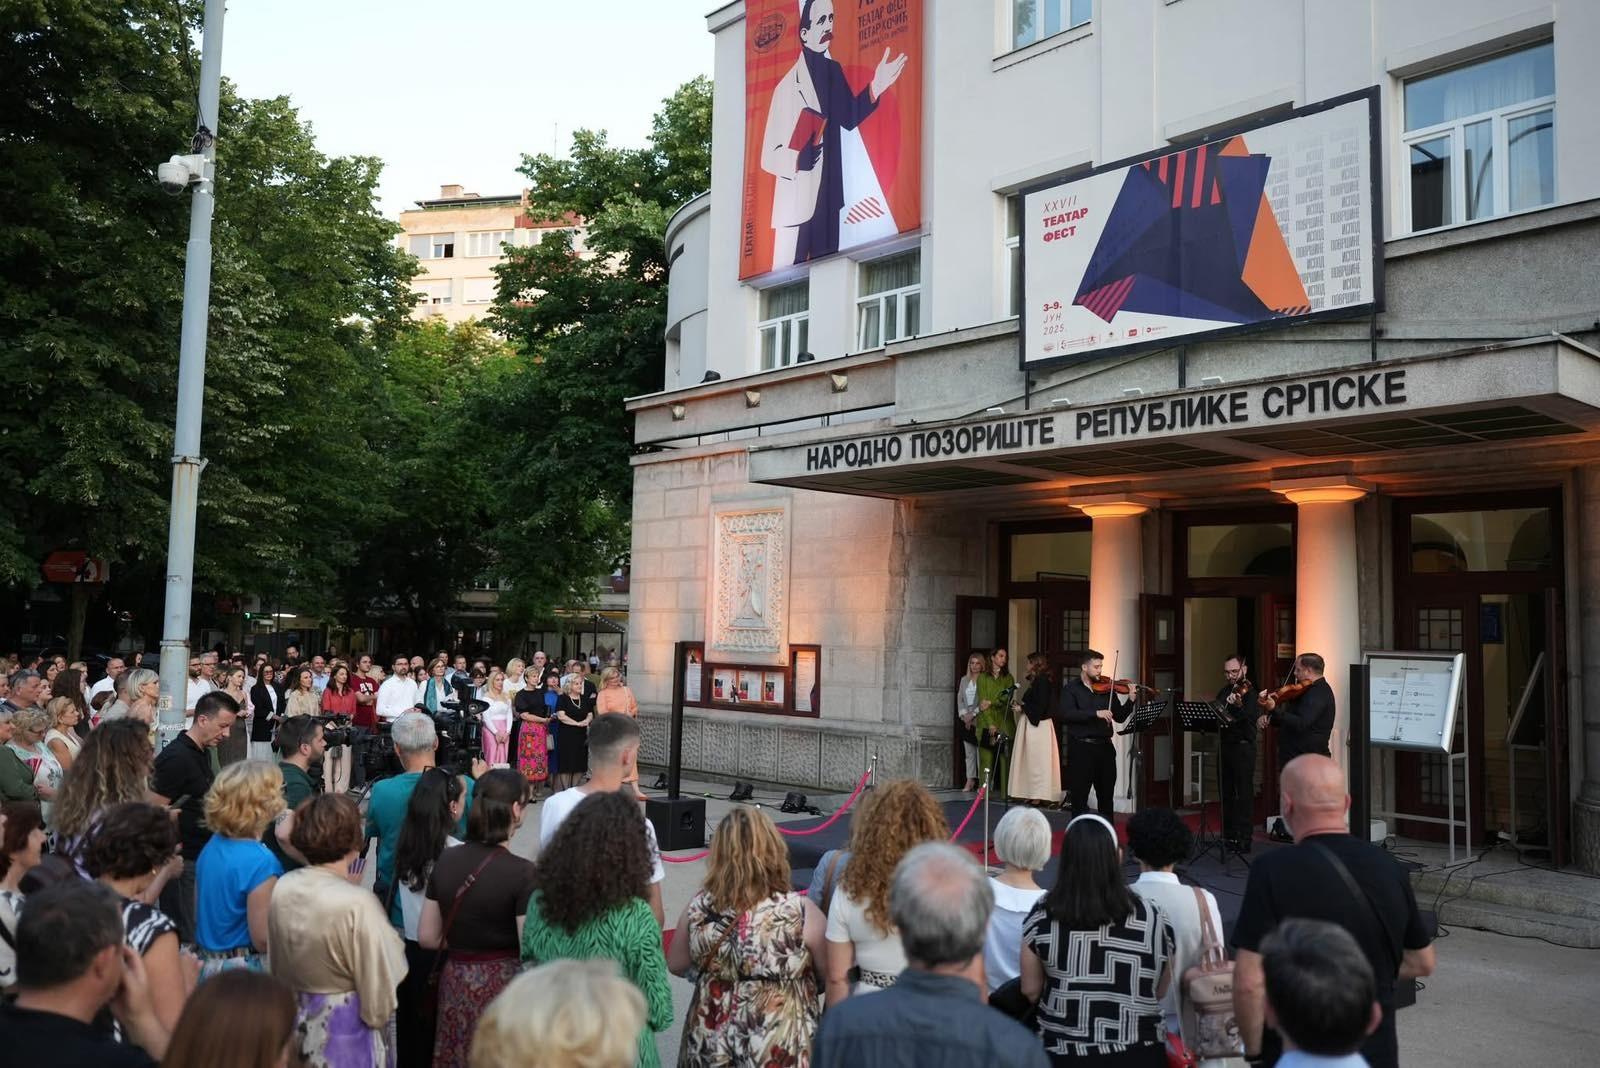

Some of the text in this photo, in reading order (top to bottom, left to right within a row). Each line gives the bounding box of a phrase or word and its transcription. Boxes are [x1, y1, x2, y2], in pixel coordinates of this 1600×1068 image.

[1043, 195, 1077, 213] XXVII
[1043, 208, 1088, 227] ТЕАТАР
[1043, 226, 1076, 242] ФЕСТ
[806, 370, 1407, 471] НАРОДНО ПОЗОРИШТЕ РЕПУБЛИКЕ СРПСКЕ
